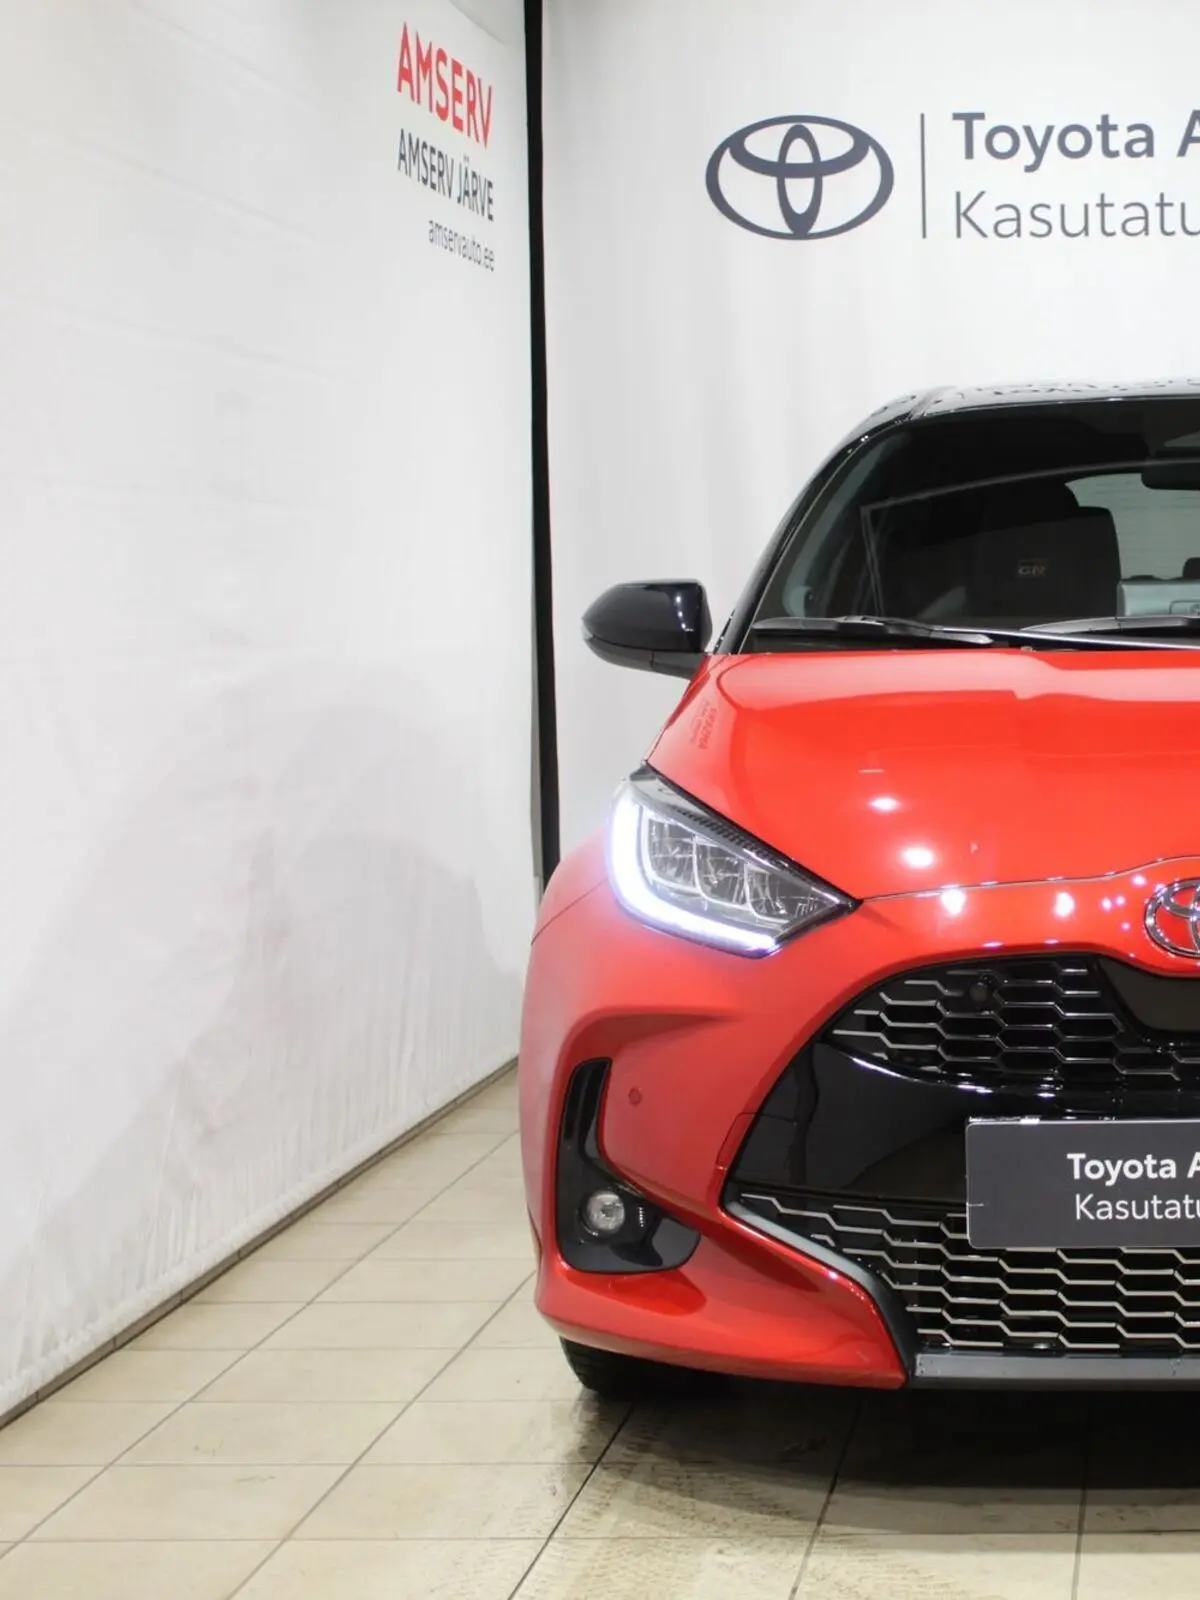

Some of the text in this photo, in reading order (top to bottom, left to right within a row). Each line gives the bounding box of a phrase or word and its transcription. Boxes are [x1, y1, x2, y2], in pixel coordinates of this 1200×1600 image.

[397, 21, 492, 148] AMSERV
[951, 111, 1156, 173] Toyota
[397, 128, 494, 222] AMSERV JÄRVE
[428, 219, 494, 272] amservauto.ee
[1066, 1152, 1177, 1187] Toyota
